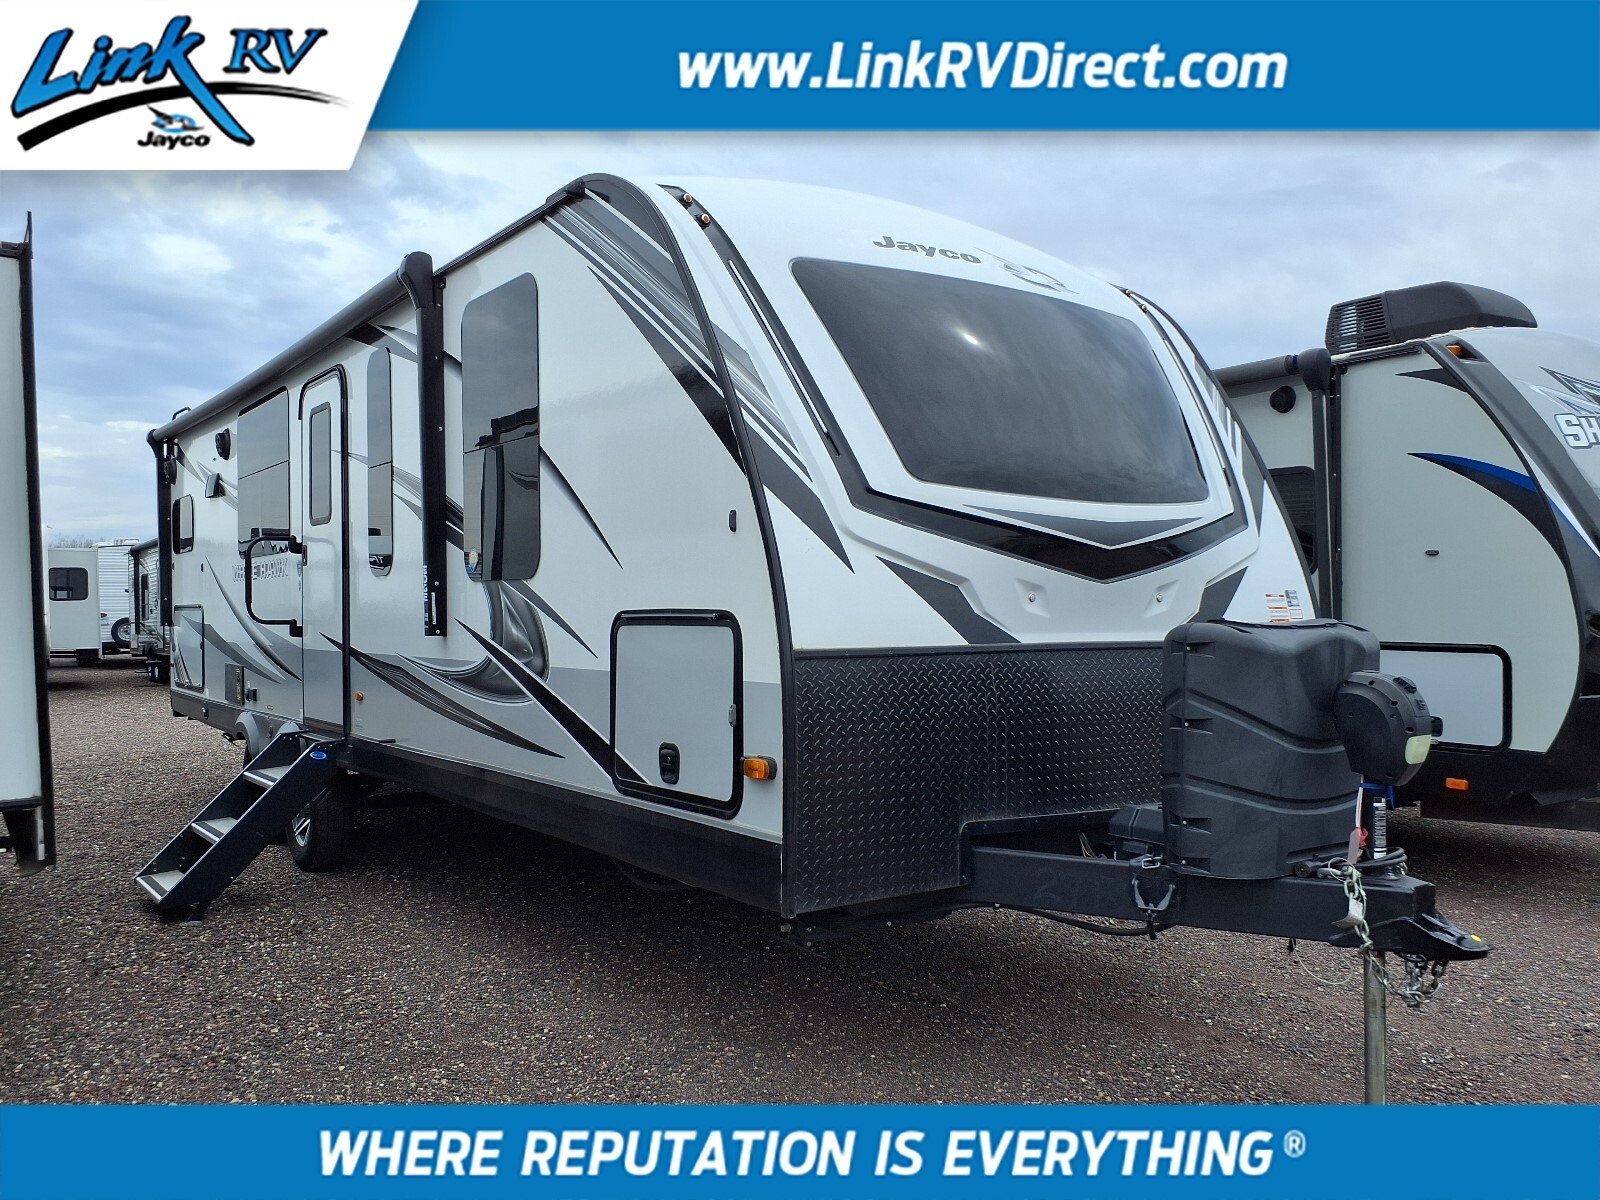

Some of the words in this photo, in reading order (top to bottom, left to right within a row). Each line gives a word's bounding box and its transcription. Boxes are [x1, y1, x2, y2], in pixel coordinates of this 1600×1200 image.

[873, 235, 982, 264] Jayco
[1554, 412, 1600, 450] SH
[232, 563, 258, 582] WHE
